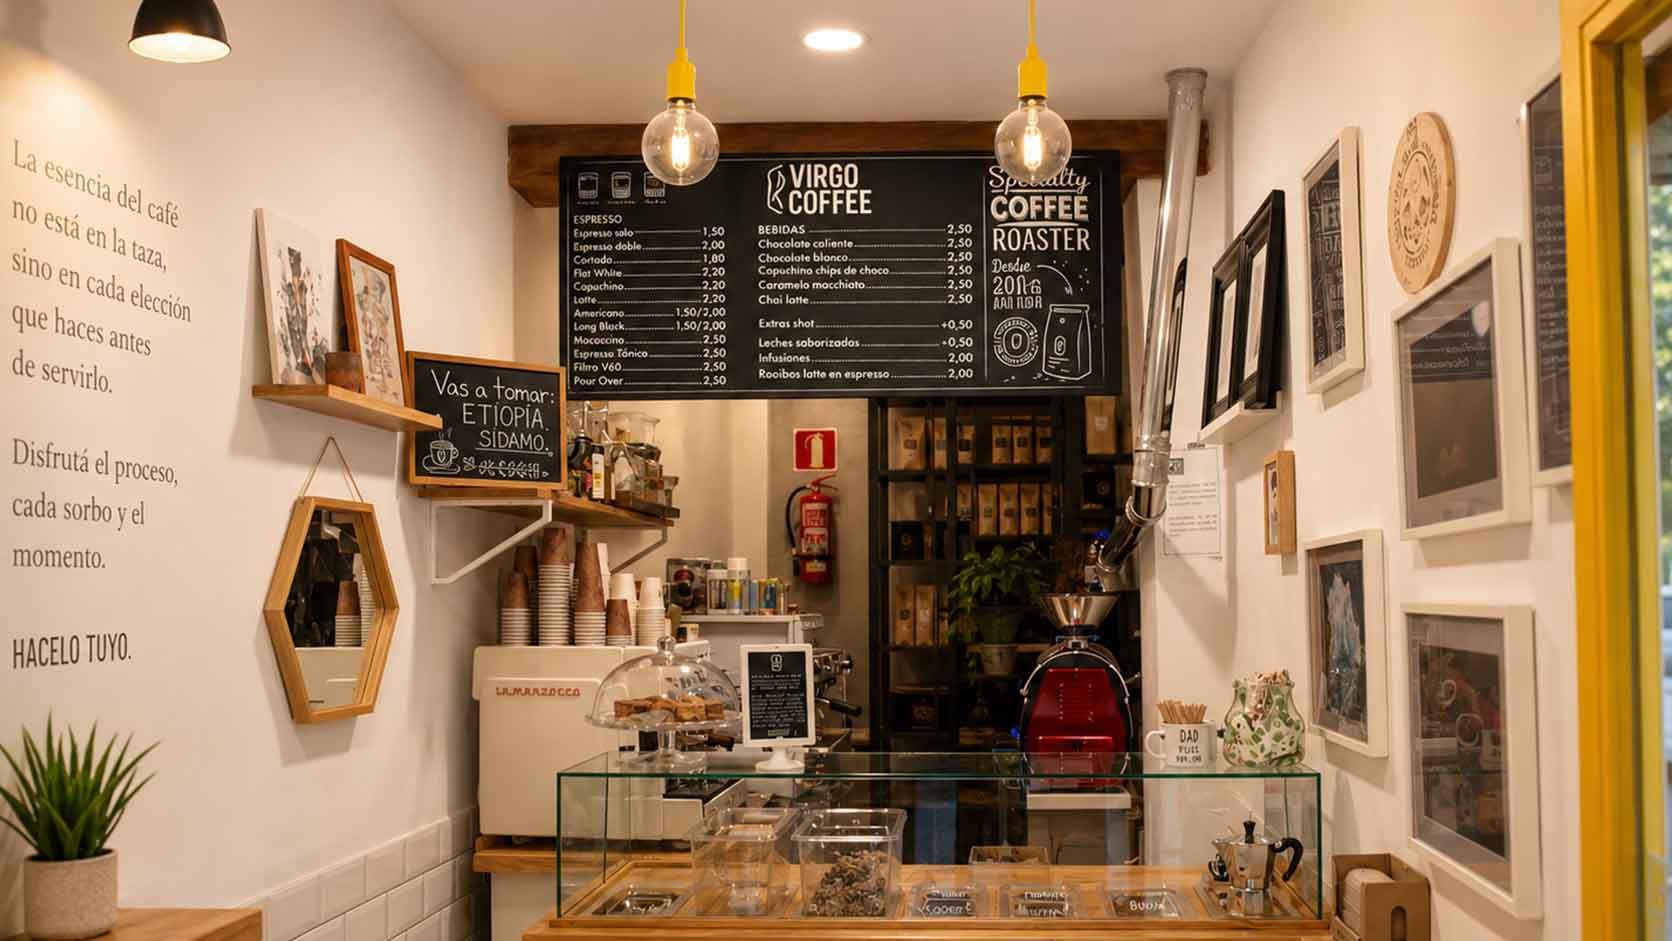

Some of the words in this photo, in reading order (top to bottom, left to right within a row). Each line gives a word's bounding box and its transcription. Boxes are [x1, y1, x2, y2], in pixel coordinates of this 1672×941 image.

[789, 164, 858, 188] VIRGO
[989, 165, 1091, 195] Spalty
[13, 138, 38, 174] La
[44, 160, 112, 203] esencia
[116, 183, 142, 215] del
[147, 201, 179, 229] café
[789, 190, 872, 214] COFFEE
[991, 195, 1088, 220] COFFEE
[573, 215, 622, 224] ESPRESSO
[573, 229, 612, 238] Espresso
[615, 228, 634, 238] solo
[703, 227, 725, 237] 1,50
[758, 225, 805, 235] BEBIDAS
[947, 224, 972, 235] 2,50
[12, 200, 38, 225] no
[44, 212, 81, 241] está
[86, 227, 107, 249] en
[112, 229, 127, 257] la
[132, 241, 167, 273] taza,
[993, 228, 1091, 251] ROASTER
[573, 242, 613, 252] Espresso
[615, 241, 642, 250] doble
[702, 241, 725, 251] 2,00
[758, 239, 810, 249] Chocolate
[813, 239, 853, 249] caliente
[947, 238, 972, 249] 2,50
[703, 254, 725, 264] 1,80
[758, 253, 811, 263] Chocolate
[813, 253, 848, 262] blanco
[947, 252, 972, 263] 2,50
[573, 270, 591, 278] Flat
[595, 269, 622, 278] White
[702, 267, 725, 277] 2,20
[758, 266, 813, 278] Capuchino
[815, 266, 842, 277] chips
[844, 266, 857, 275] de
[860, 266, 889, 275] choco
[947, 265, 973, 277] 2,50
[11, 247, 53, 281] sino
[58, 267, 81, 290] en
[86, 274, 126, 303] cada
[130, 283, 192, 323] elección
[573, 282, 624, 292] Capuchino
[702, 281, 726, 291] 2,20
[758, 280, 810, 290] Caramelo
[812, 280, 865, 290] macchiato
[947, 280, 973, 291] 2,50
[574, 296, 597, 304] Latte
[702, 294, 726, 304] 2,20
[758, 295, 783, 305] Chai
[786, 295, 809, 305] latte
[947, 294, 973, 306] 2,50
[573, 309, 624, 318] Americano
[11, 305, 48, 334] que
[54, 306, 104, 345] haces
[109, 330, 152, 356] antes
[574, 322, 597, 333] Long
[600, 322, 624, 331] Black
[758, 319, 790, 329] Extras
[793, 319, 815, 328] shot
[941, 319, 973, 331] +0,50
[703, 335, 727, 345] 2,50
[758, 338, 793, 348] Leches
[574, 350, 614, 359] Espresso
[617, 349, 648, 358] Tónico
[703, 349, 727, 359] 2,50
[758, 353, 810, 363] Infusiones
[948, 352, 973, 364] 2,00
[11, 348, 36, 379] de
[41, 363, 113, 394] servirlo.
[574, 363, 598, 372] Filtro
[602, 363, 622, 371] V60
[703, 362, 727, 373] 2,50
[574, 377, 596, 385] Pour
[599, 377, 623, 385] Over
[703, 376, 727, 387] 2,50
[759, 369, 800, 379] Rooibos
[803, 369, 827, 379] latte
[829, 370, 842, 379] en
[844, 370, 890, 382] espresso
[948, 369, 973, 380] 2,00
[431, 369, 469, 398] Vas
[475, 386, 487, 398] a
[493, 375, 555, 404] tomar:
[12, 437, 89, 473] Disfrutá
[94, 450, 110, 476] el
[114, 460, 178, 488] proceso,
[12, 492, 57, 519] cada
[63, 495, 113, 523] sorbo
[117, 506, 128, 532] y
[131, 500, 145, 525] el
[12, 548, 106, 569] momento.
[12, 634, 80, 670] HACELO
[85, 632, 132, 663] TUYO.
[1180, 729, 1199, 743] DAD
